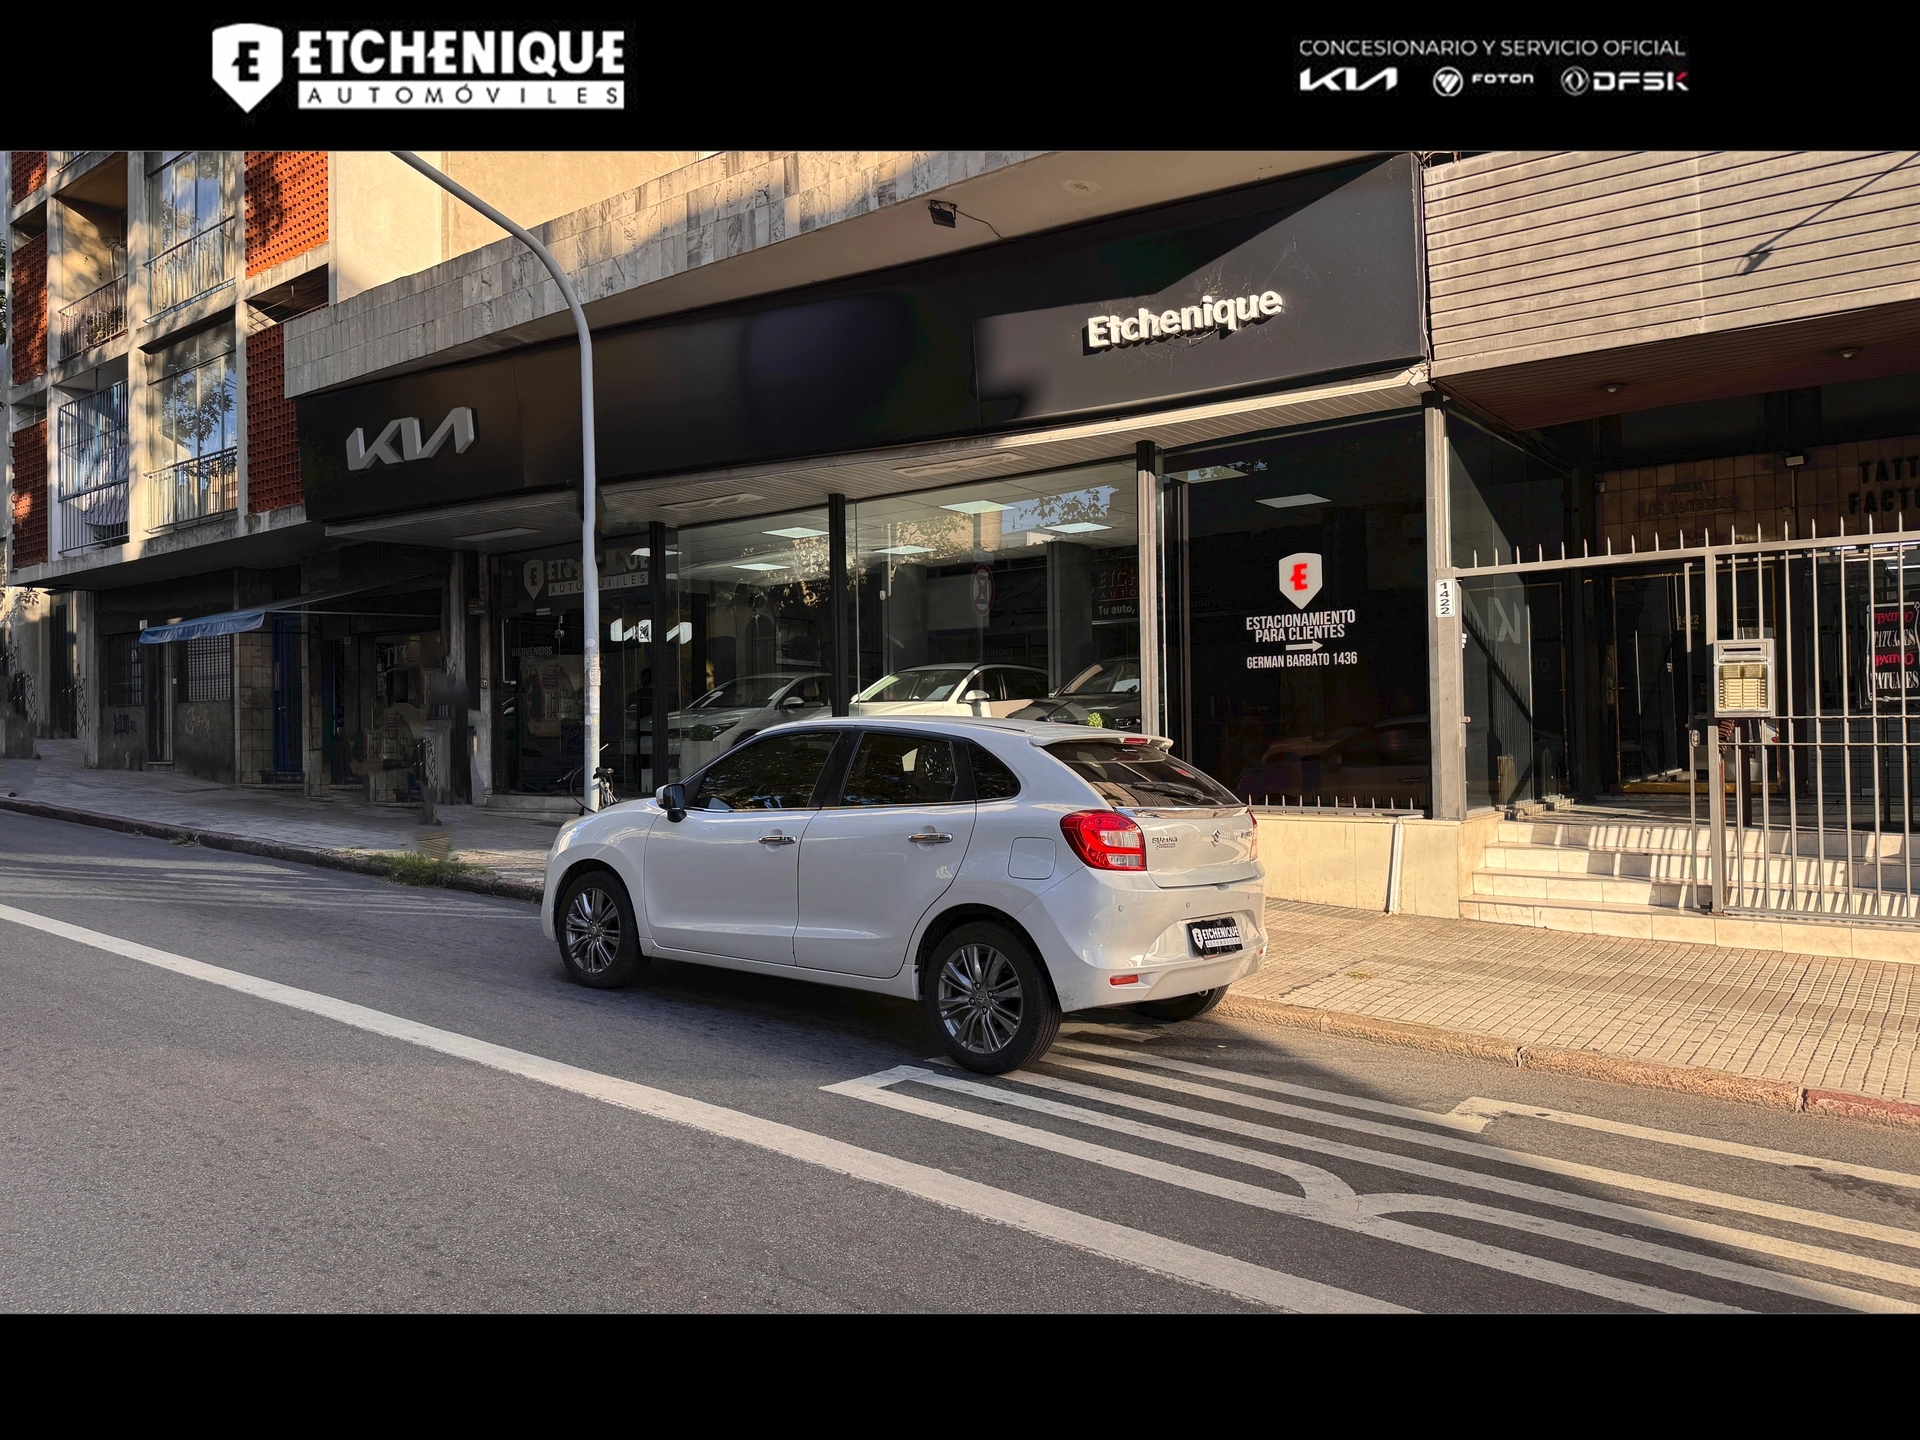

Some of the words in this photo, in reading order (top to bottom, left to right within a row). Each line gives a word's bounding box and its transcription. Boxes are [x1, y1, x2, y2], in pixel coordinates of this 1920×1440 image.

[1087, 290, 1283, 348] Etchenique
[345, 406, 475, 471] KIA
[1439, 581, 1451, 615] 1422
[1098, 605, 1109, 616] Tu
[1110, 604, 1136, 615] auto,
[1246, 609, 1356, 631] ESTACIONAMIENTO
[1255, 628, 1286, 643] PARA
[1288, 624, 1345, 642] CLIENTES
[511, 646, 553, 657] BIENVENIDOS
[1246, 655, 1284, 669] GERMAN
[1286, 652, 1330, 668] BARBATO
[1333, 651, 1358, 665] 1436
[1201, 925, 1240, 940] ETCHENIQUE
